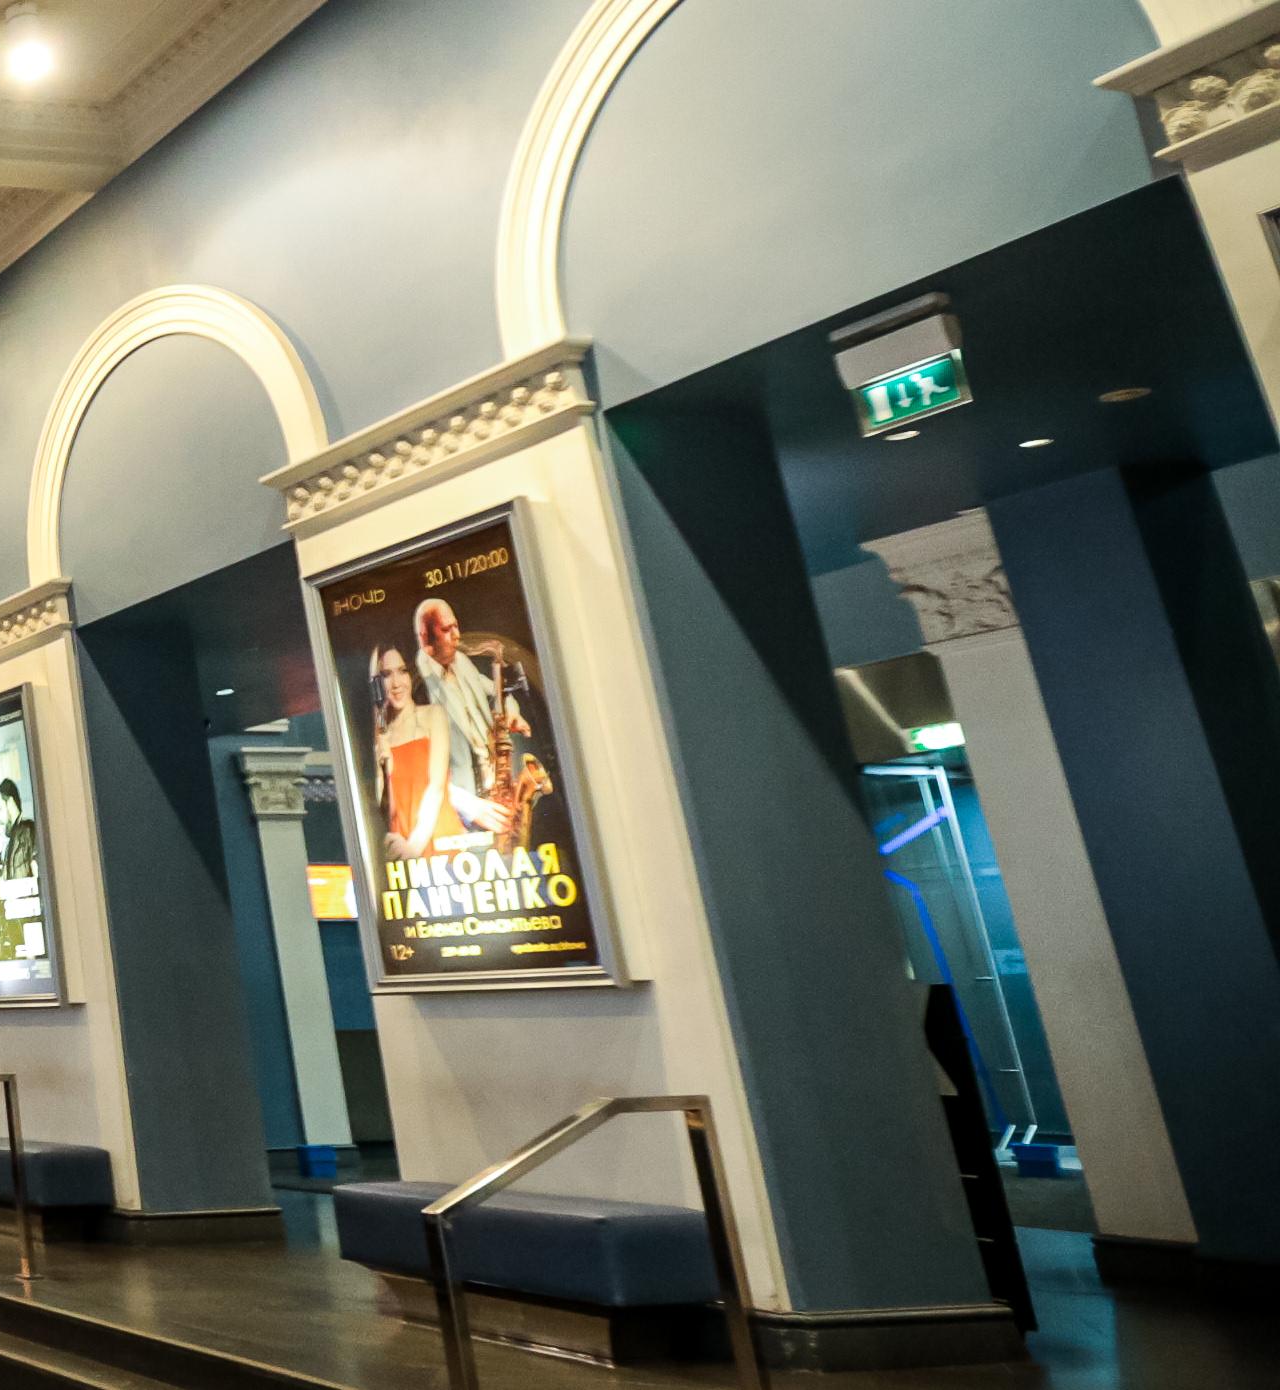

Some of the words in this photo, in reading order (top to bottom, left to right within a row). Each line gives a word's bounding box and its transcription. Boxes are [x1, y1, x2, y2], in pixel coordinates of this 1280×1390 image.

[424, 547, 510, 589] 30.11/20:00
[386, 843, 561, 890] НИКОЛАЯ
[382, 874, 578, 920] ПАНЧЕНКО
[390, 944, 415, 960] 12+
